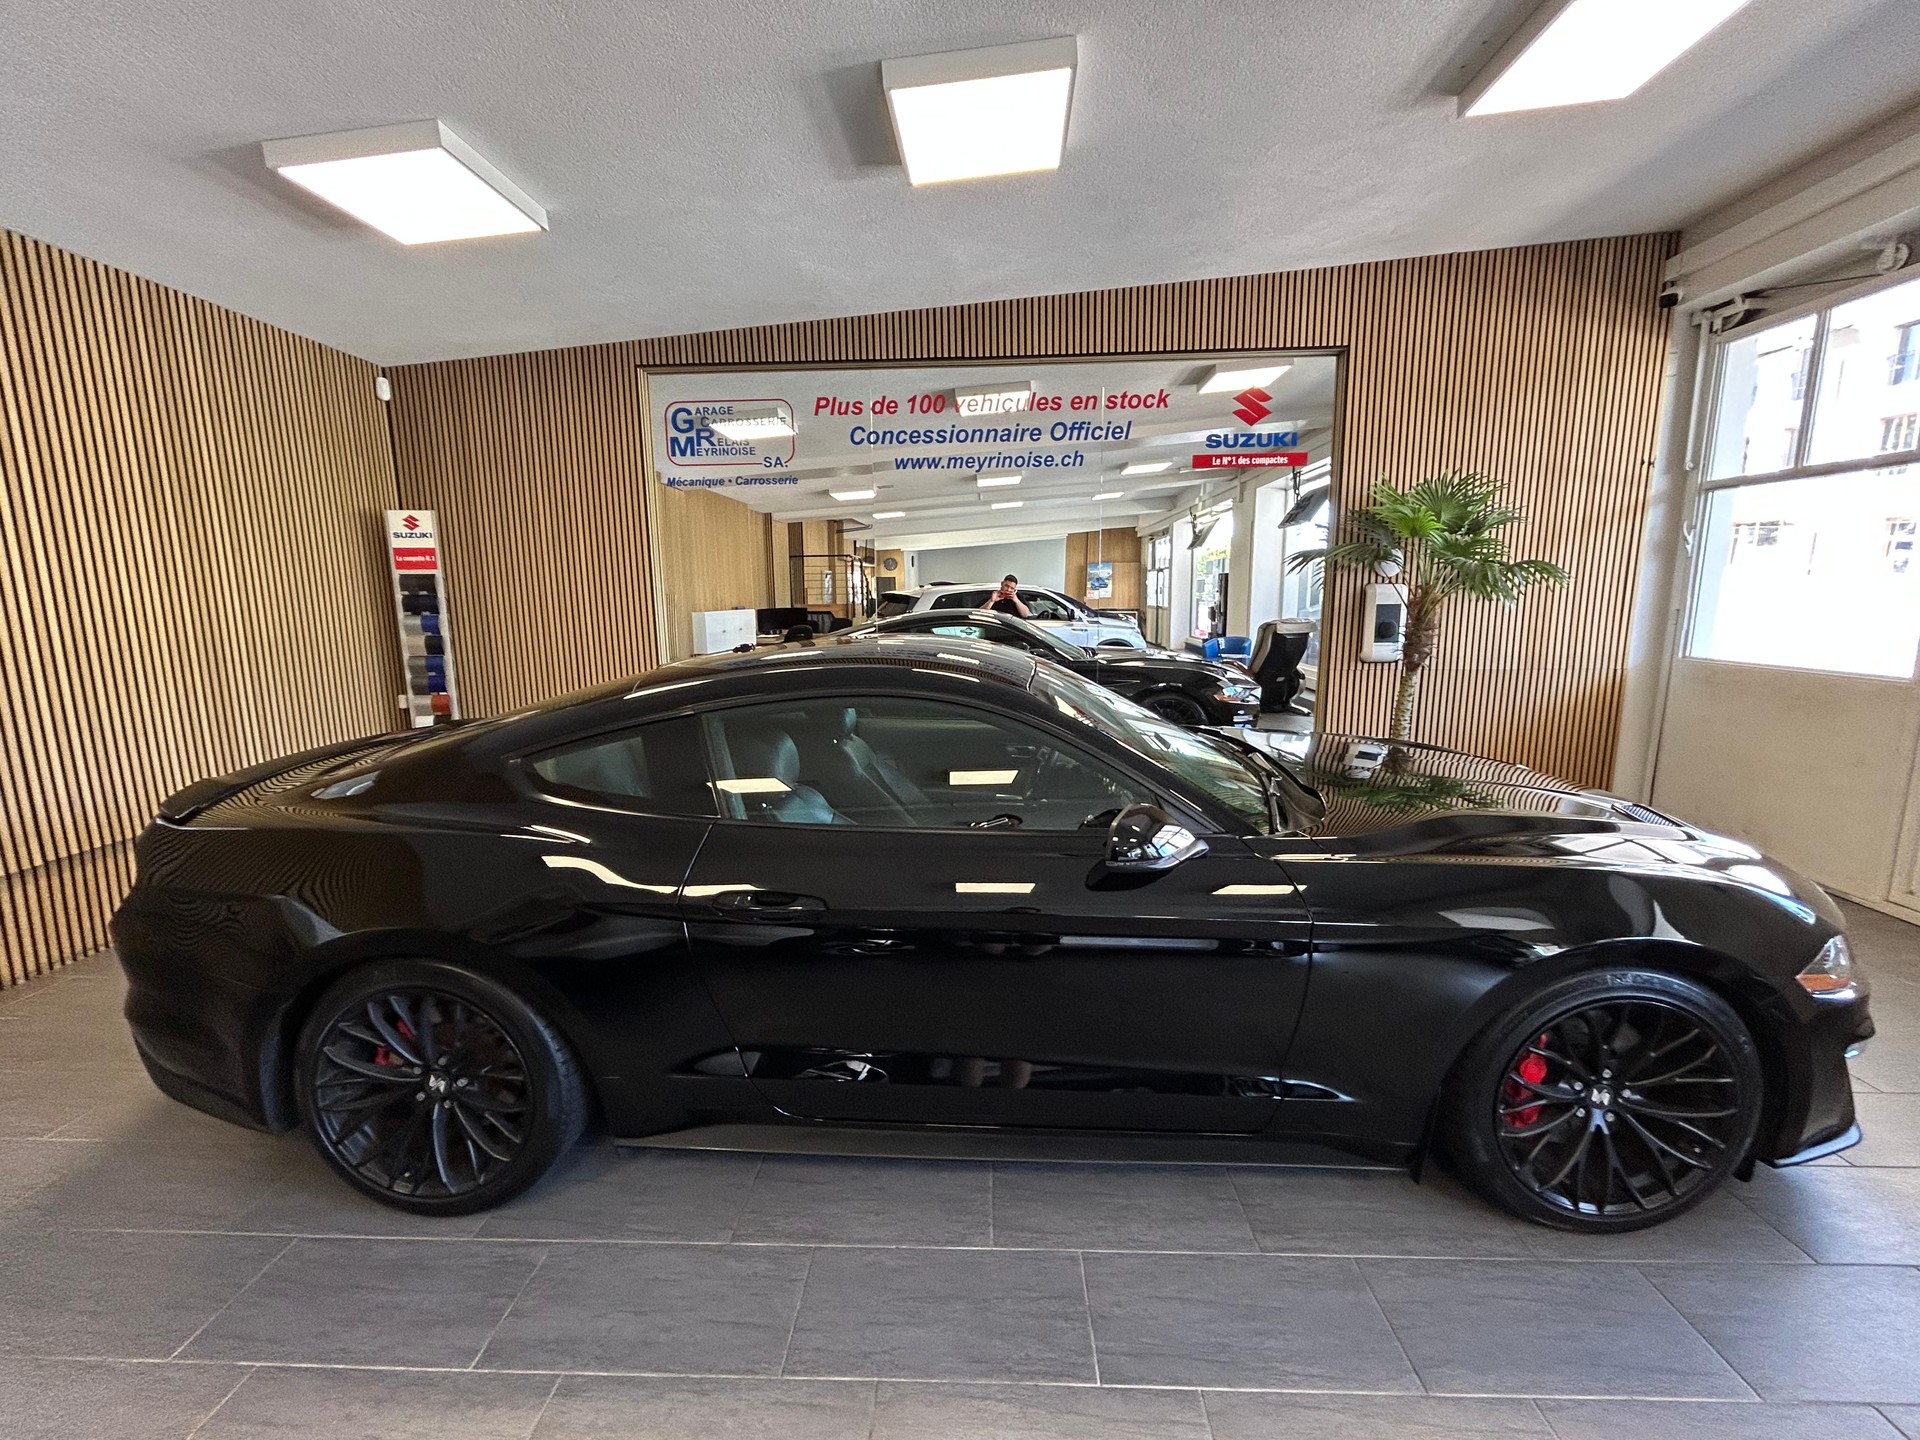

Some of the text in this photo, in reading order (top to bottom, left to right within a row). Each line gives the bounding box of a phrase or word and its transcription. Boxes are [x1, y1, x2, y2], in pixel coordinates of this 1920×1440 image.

[814, 396, 863, 416] Plus
[871, 395, 899, 415] de
[907, 394, 946, 414] 100
[1069, 394, 1098, 411] en
[1105, 389, 1171, 409] stock
[671, 406, 734, 433] GARAGE
[849, 421, 1132, 446] Concessionnaire Officiel
[1205, 432, 1298, 448] SUZUKI
[669, 436, 756, 457] MEYRINOISE
[894, 451, 1085, 473] www.meyrinoise.ch
[1212, 456, 1221, 466] Le
[1238, 456, 1250, 465] des
[1251, 456, 1288, 466] compactes
[666, 474, 799, 489] Mécanique Carrosserie
[392, 531, 433, 539] SUZUKI
